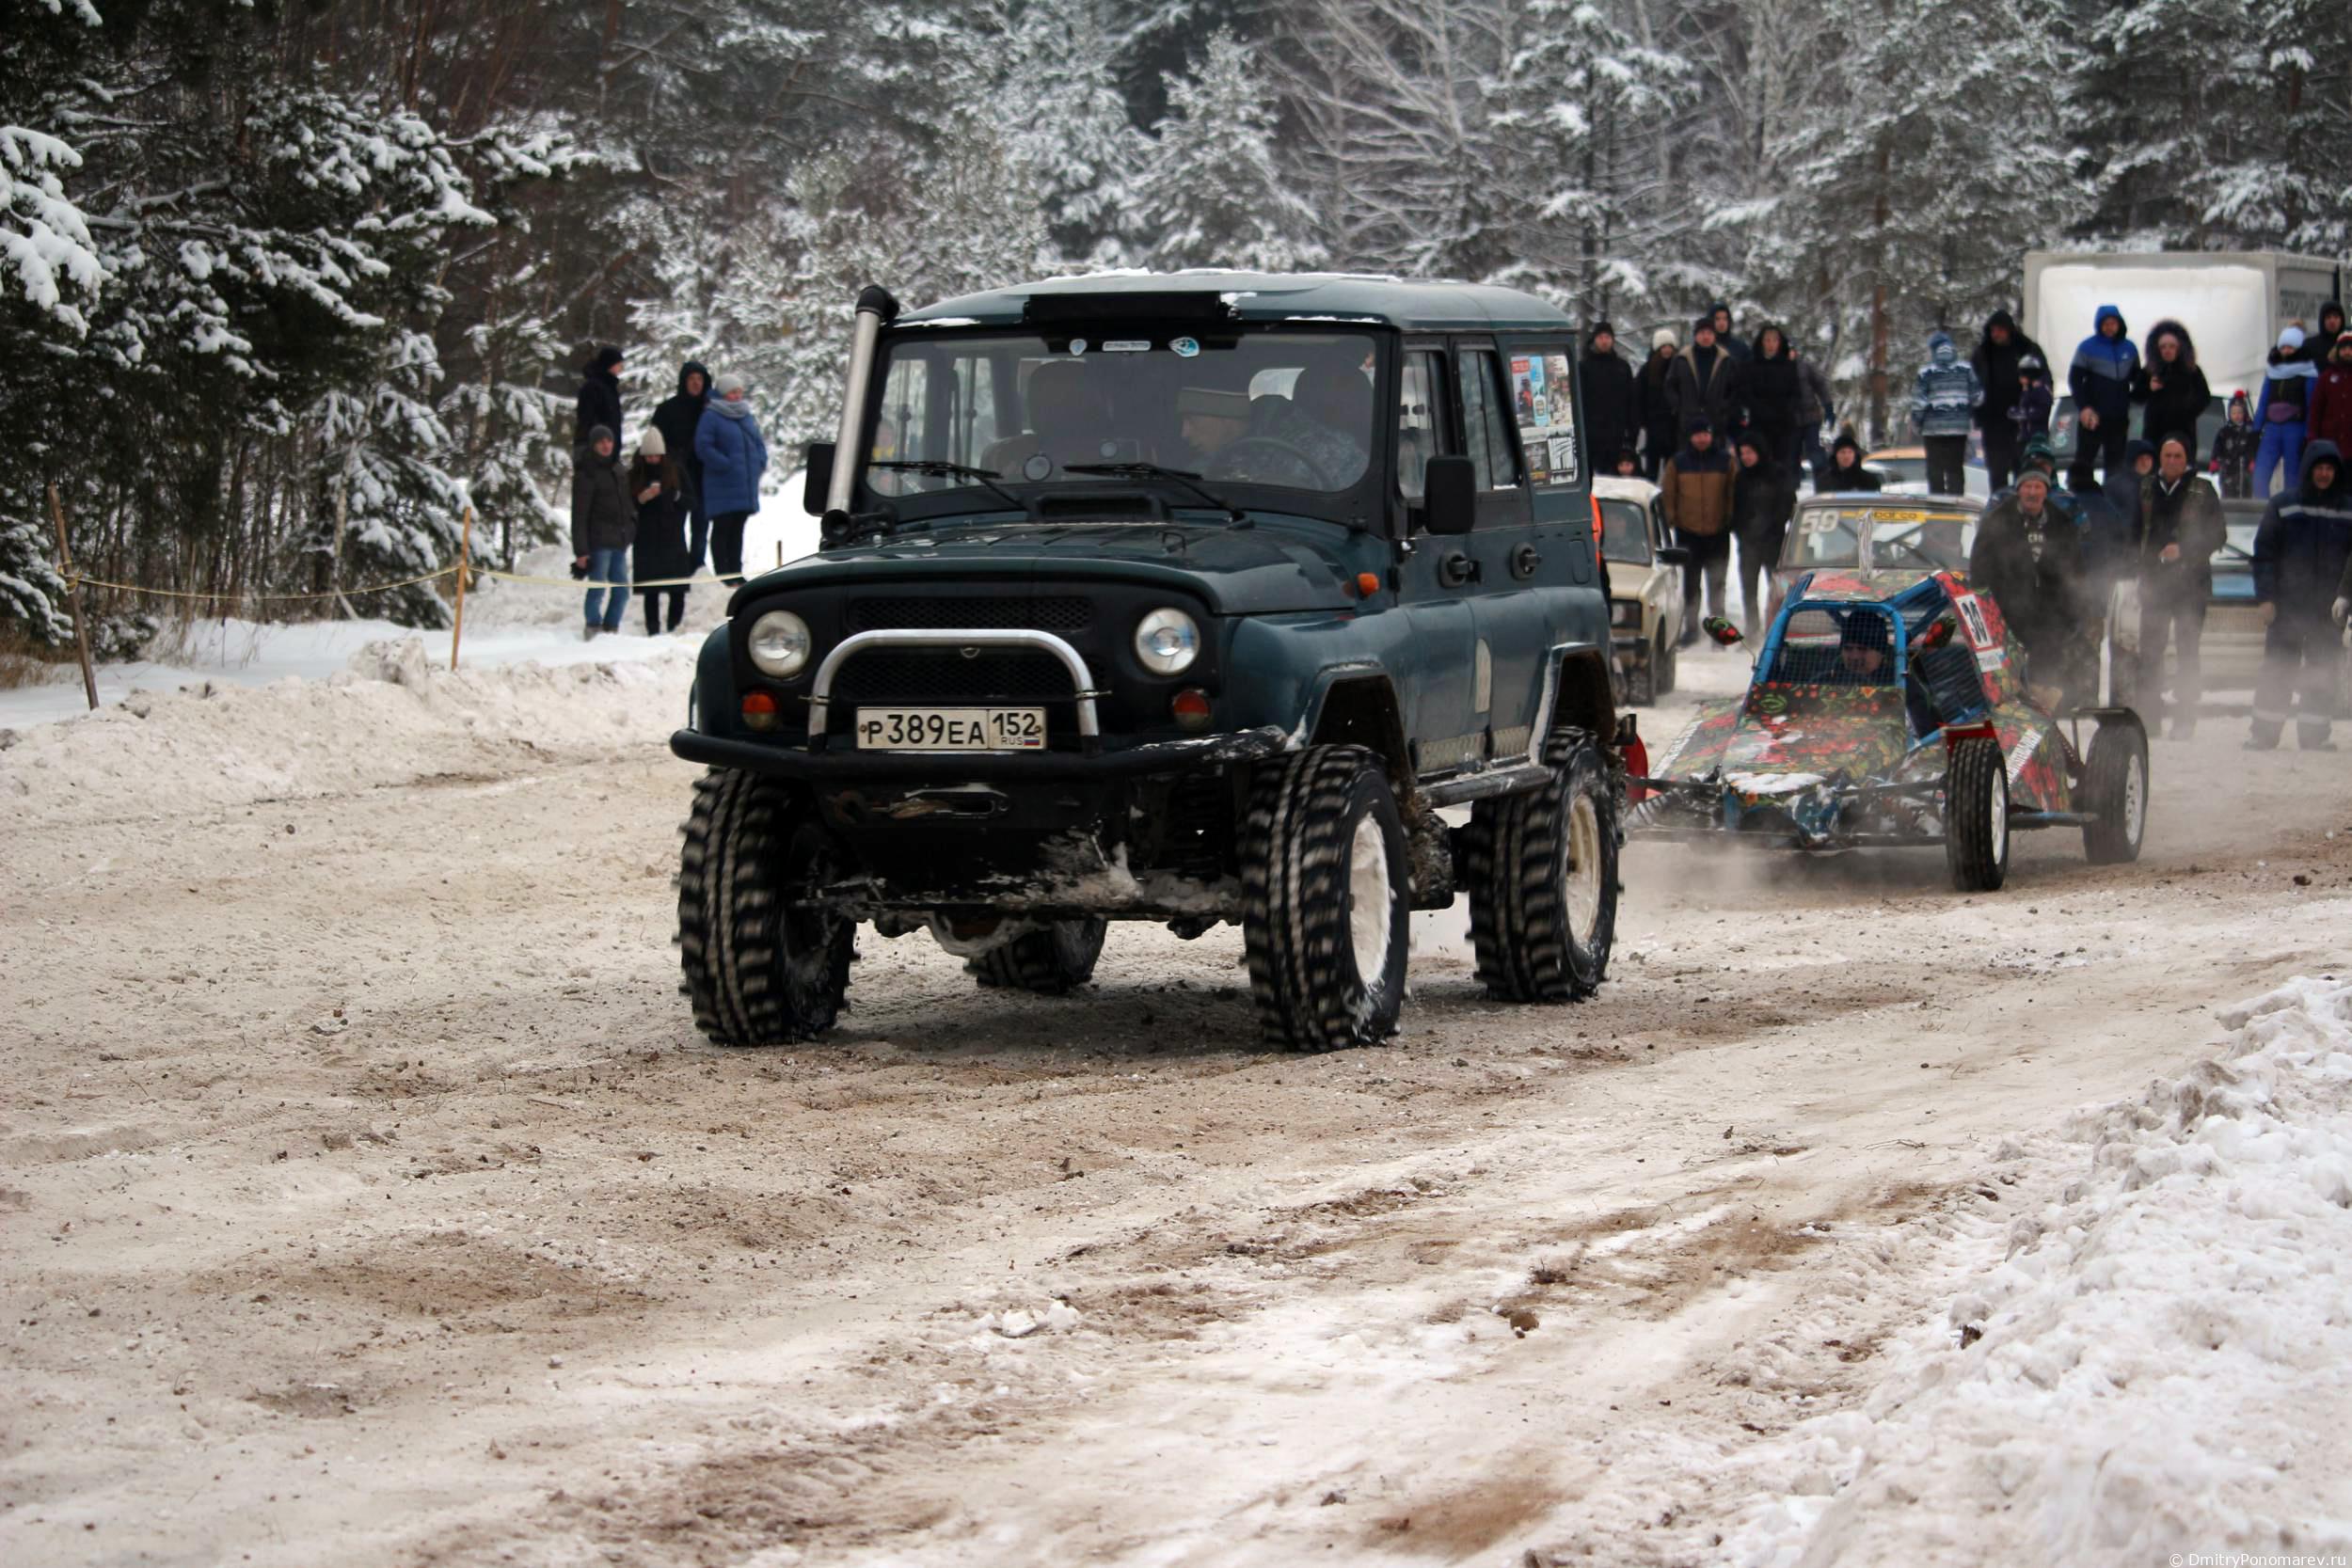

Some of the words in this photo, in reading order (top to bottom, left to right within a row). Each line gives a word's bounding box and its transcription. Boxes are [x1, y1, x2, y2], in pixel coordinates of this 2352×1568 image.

[1799, 510, 1839, 534] 59
[867, 714, 985, 745] Р389ЕА
[993, 712, 1037, 736] 152
[1001, 736, 1024, 746] RUS
